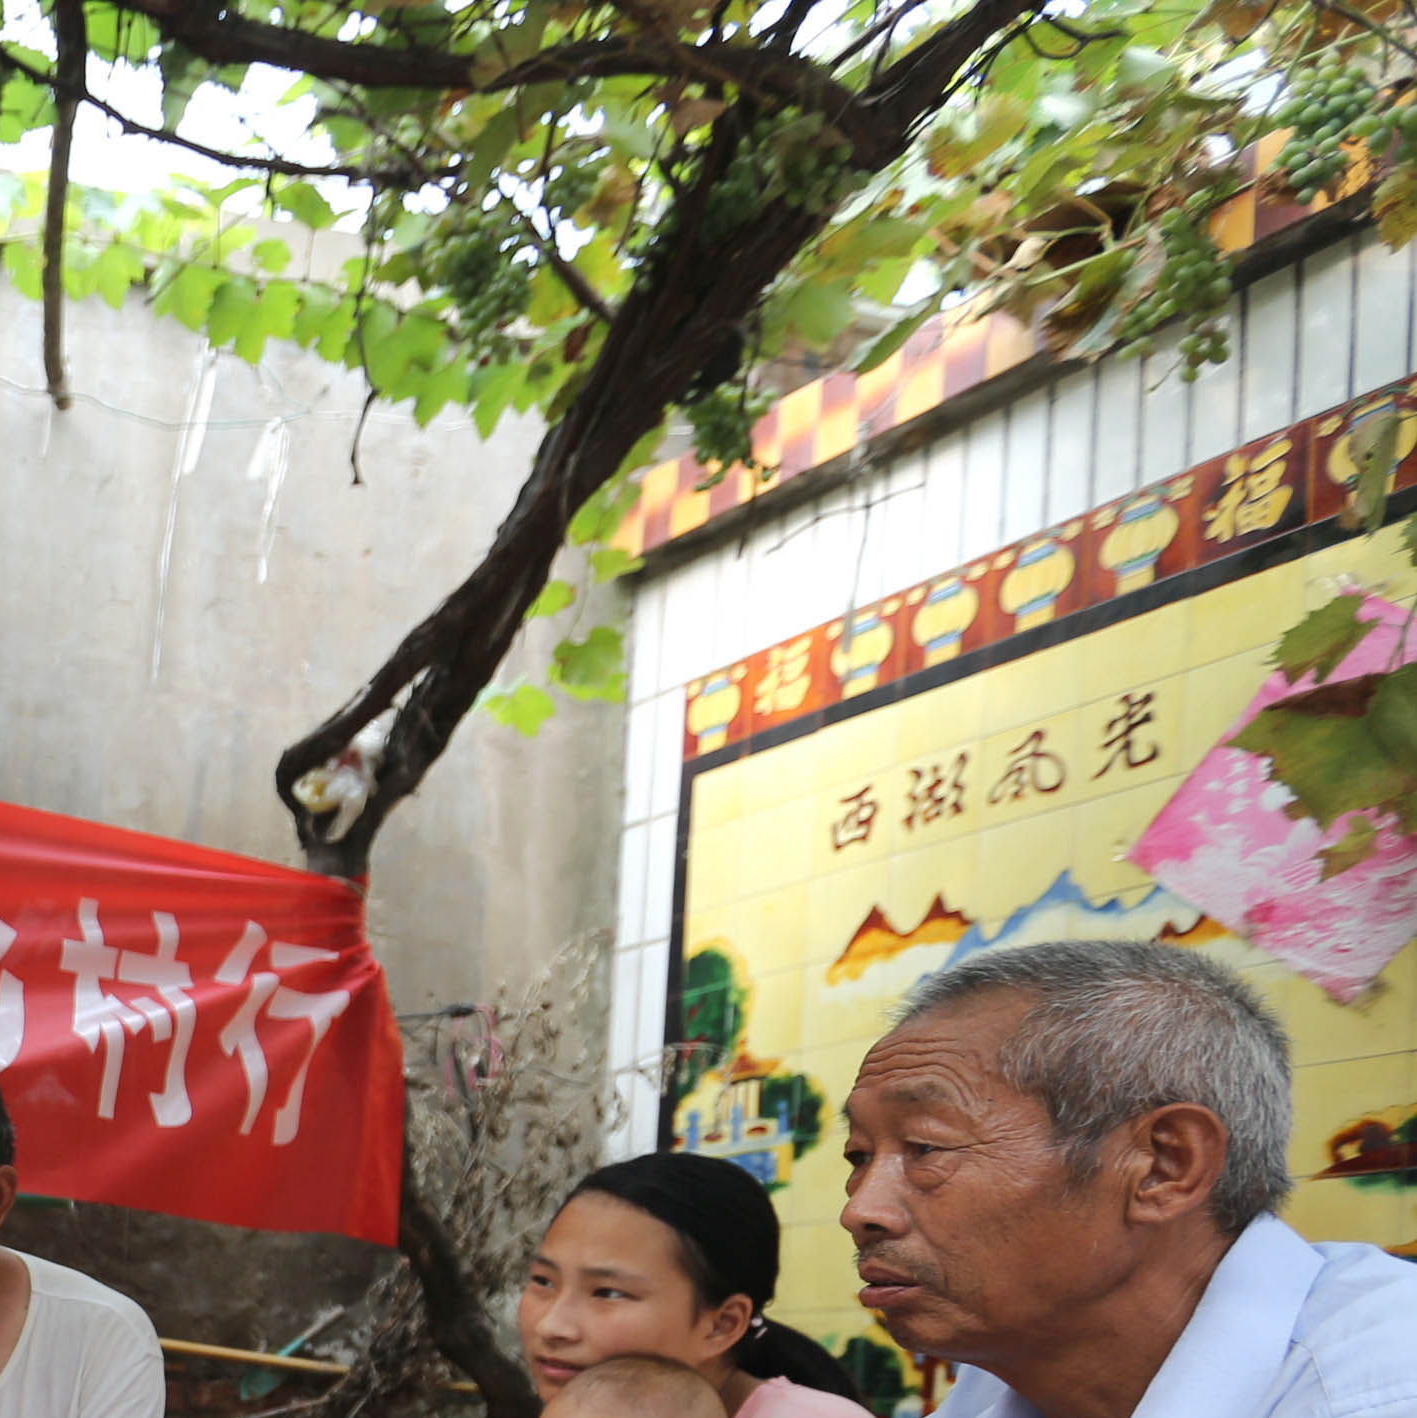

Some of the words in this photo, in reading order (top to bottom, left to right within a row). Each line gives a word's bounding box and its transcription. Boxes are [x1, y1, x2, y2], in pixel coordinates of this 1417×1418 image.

[1203, 437, 1295, 545] 福
[754, 636, 813, 719] 福
[831, 690, 1161, 853] 西湖风光
